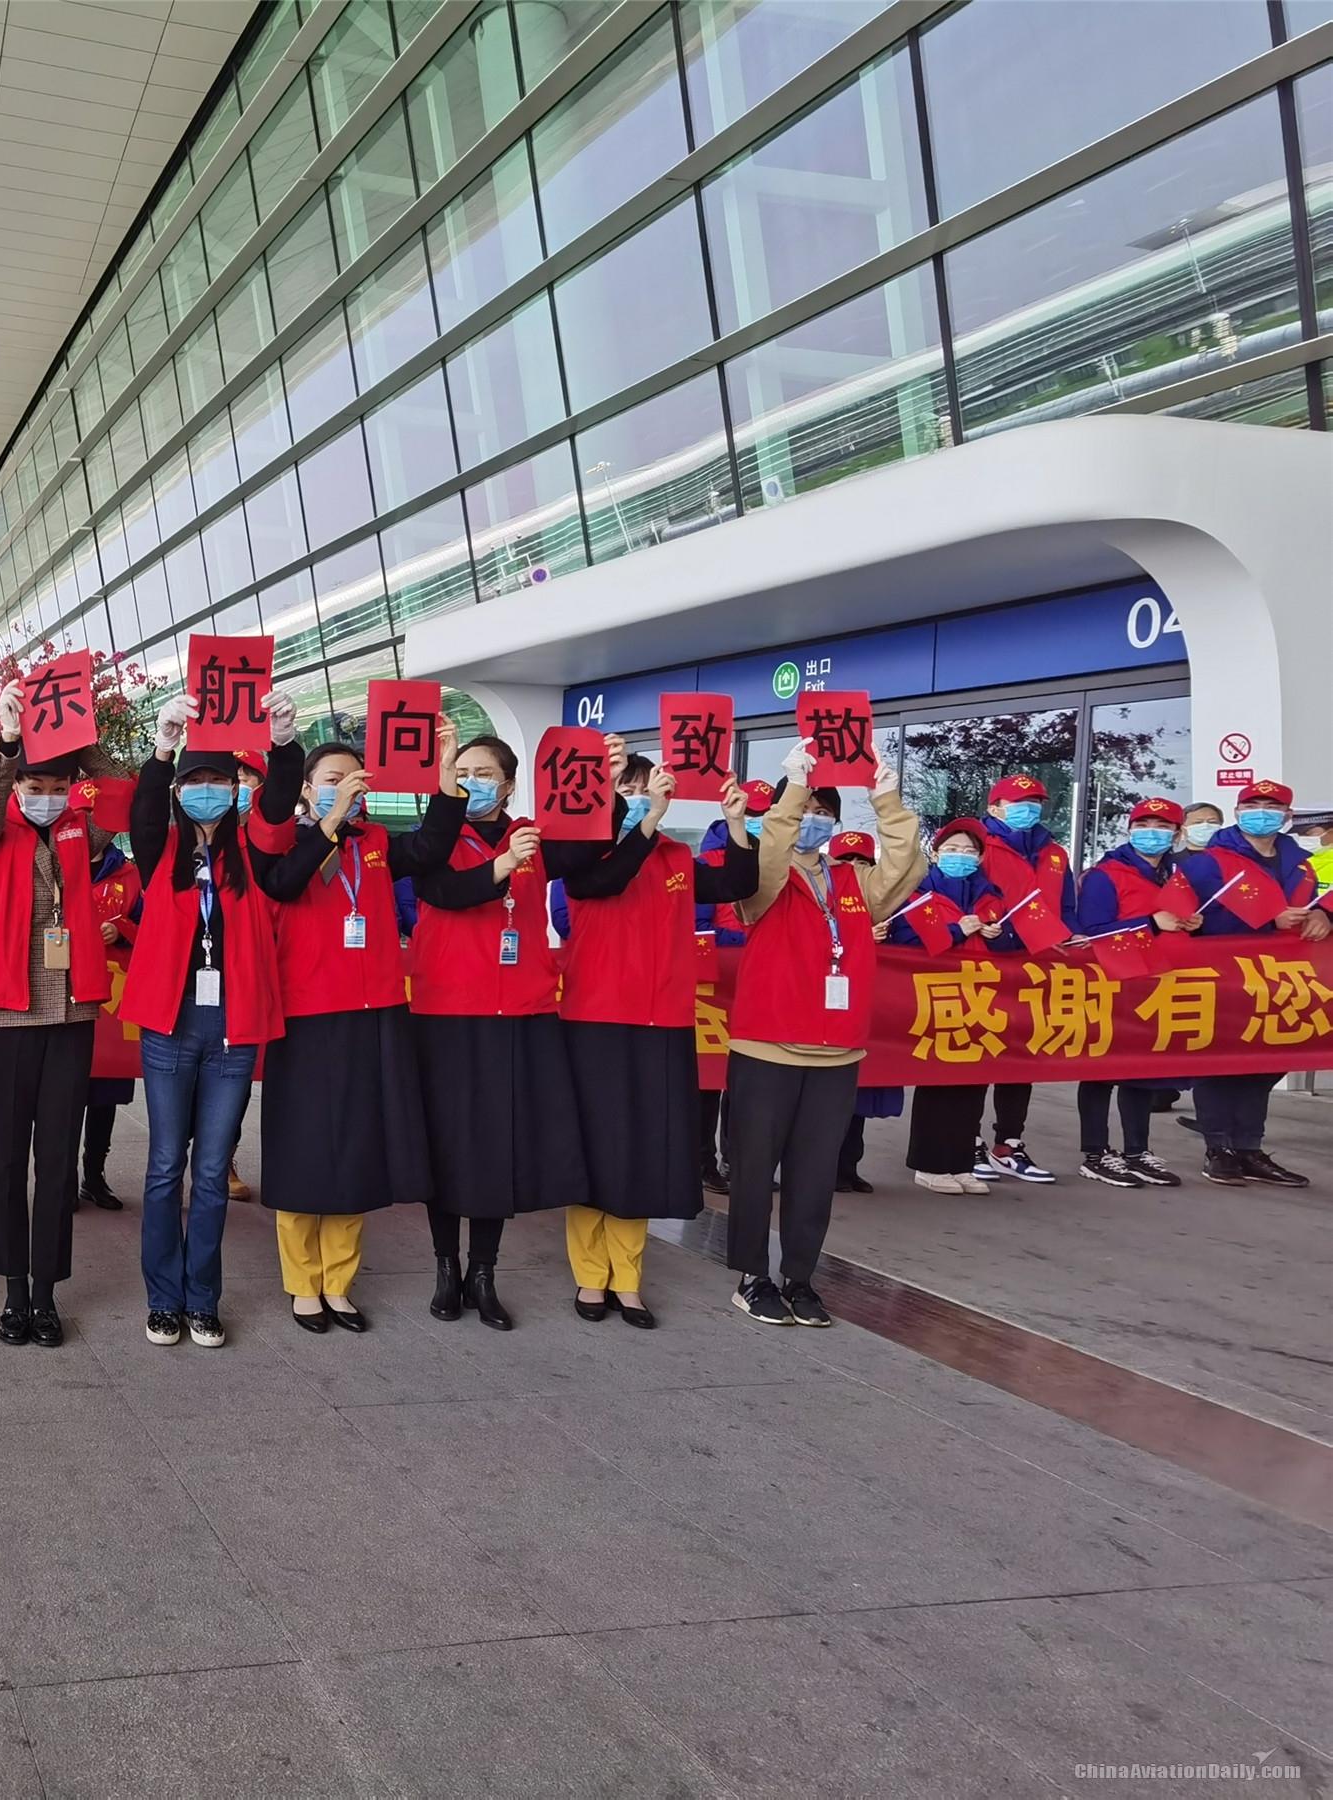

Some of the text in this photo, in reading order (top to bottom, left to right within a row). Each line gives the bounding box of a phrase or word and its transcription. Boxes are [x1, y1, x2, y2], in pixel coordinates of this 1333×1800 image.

[195, 654, 268, 726] 航
[805, 658, 831, 676] 出口
[805, 679, 825, 692] Exit
[25, 668, 87, 734] 东
[577, 694, 605, 728] 04
[378, 700, 436, 769] 向
[670, 712, 728, 778] 致
[805, 707, 876, 765] 敬
[541, 746, 606, 816] 您
[908, 954, 1333, 1063] 感谢有您
